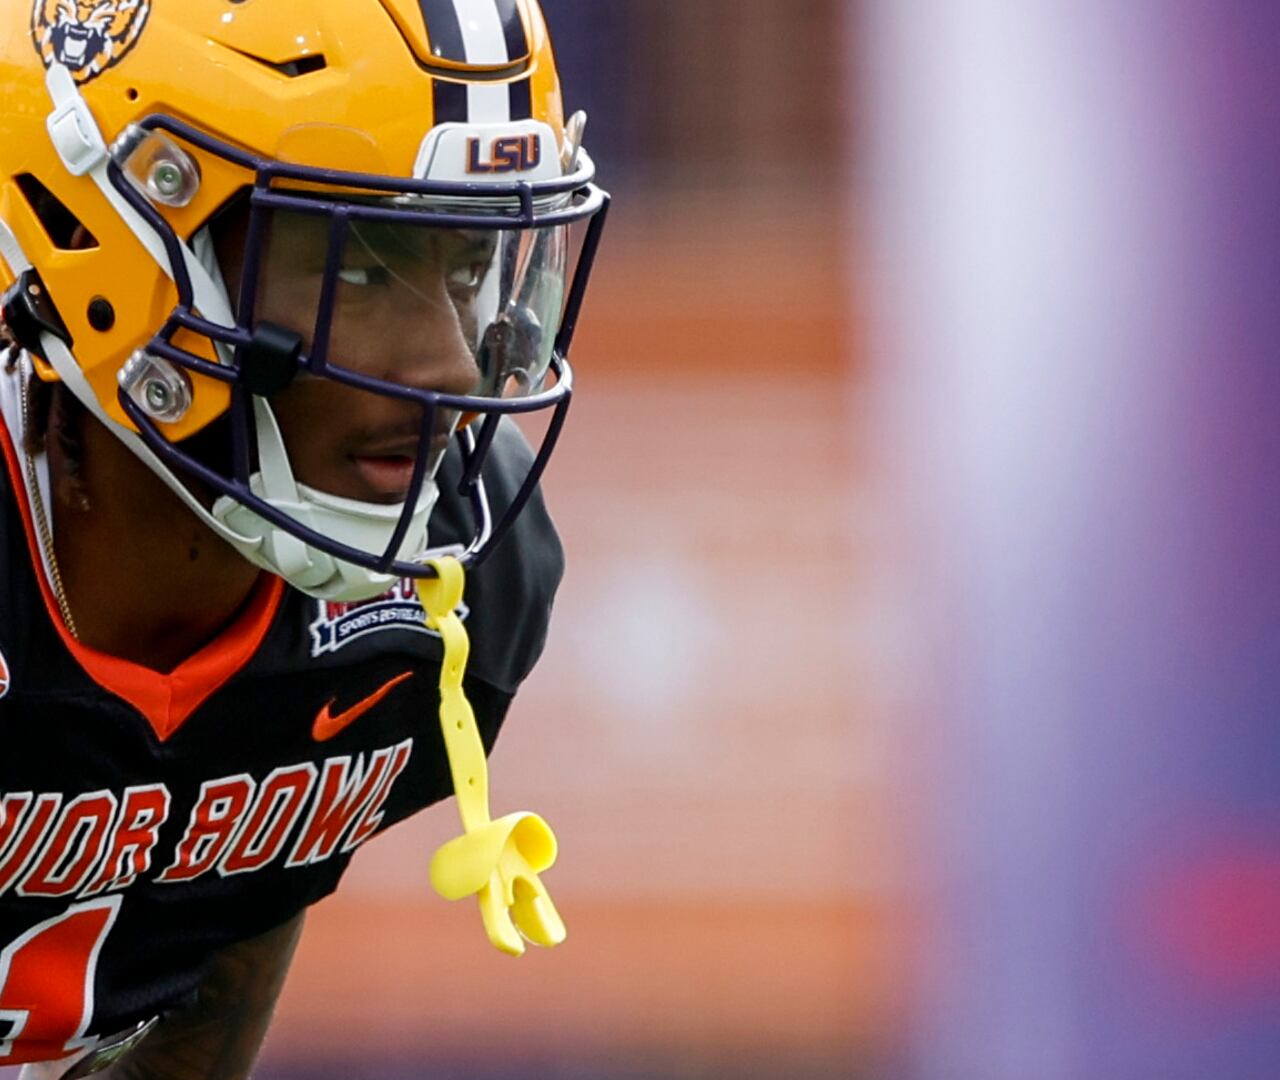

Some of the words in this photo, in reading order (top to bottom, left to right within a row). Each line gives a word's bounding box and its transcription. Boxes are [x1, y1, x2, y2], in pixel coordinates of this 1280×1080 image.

[465, 133, 540, 174] LSU
[339, 610, 378, 636] SPORTS
[161, 738, 413, 883] BOWL
